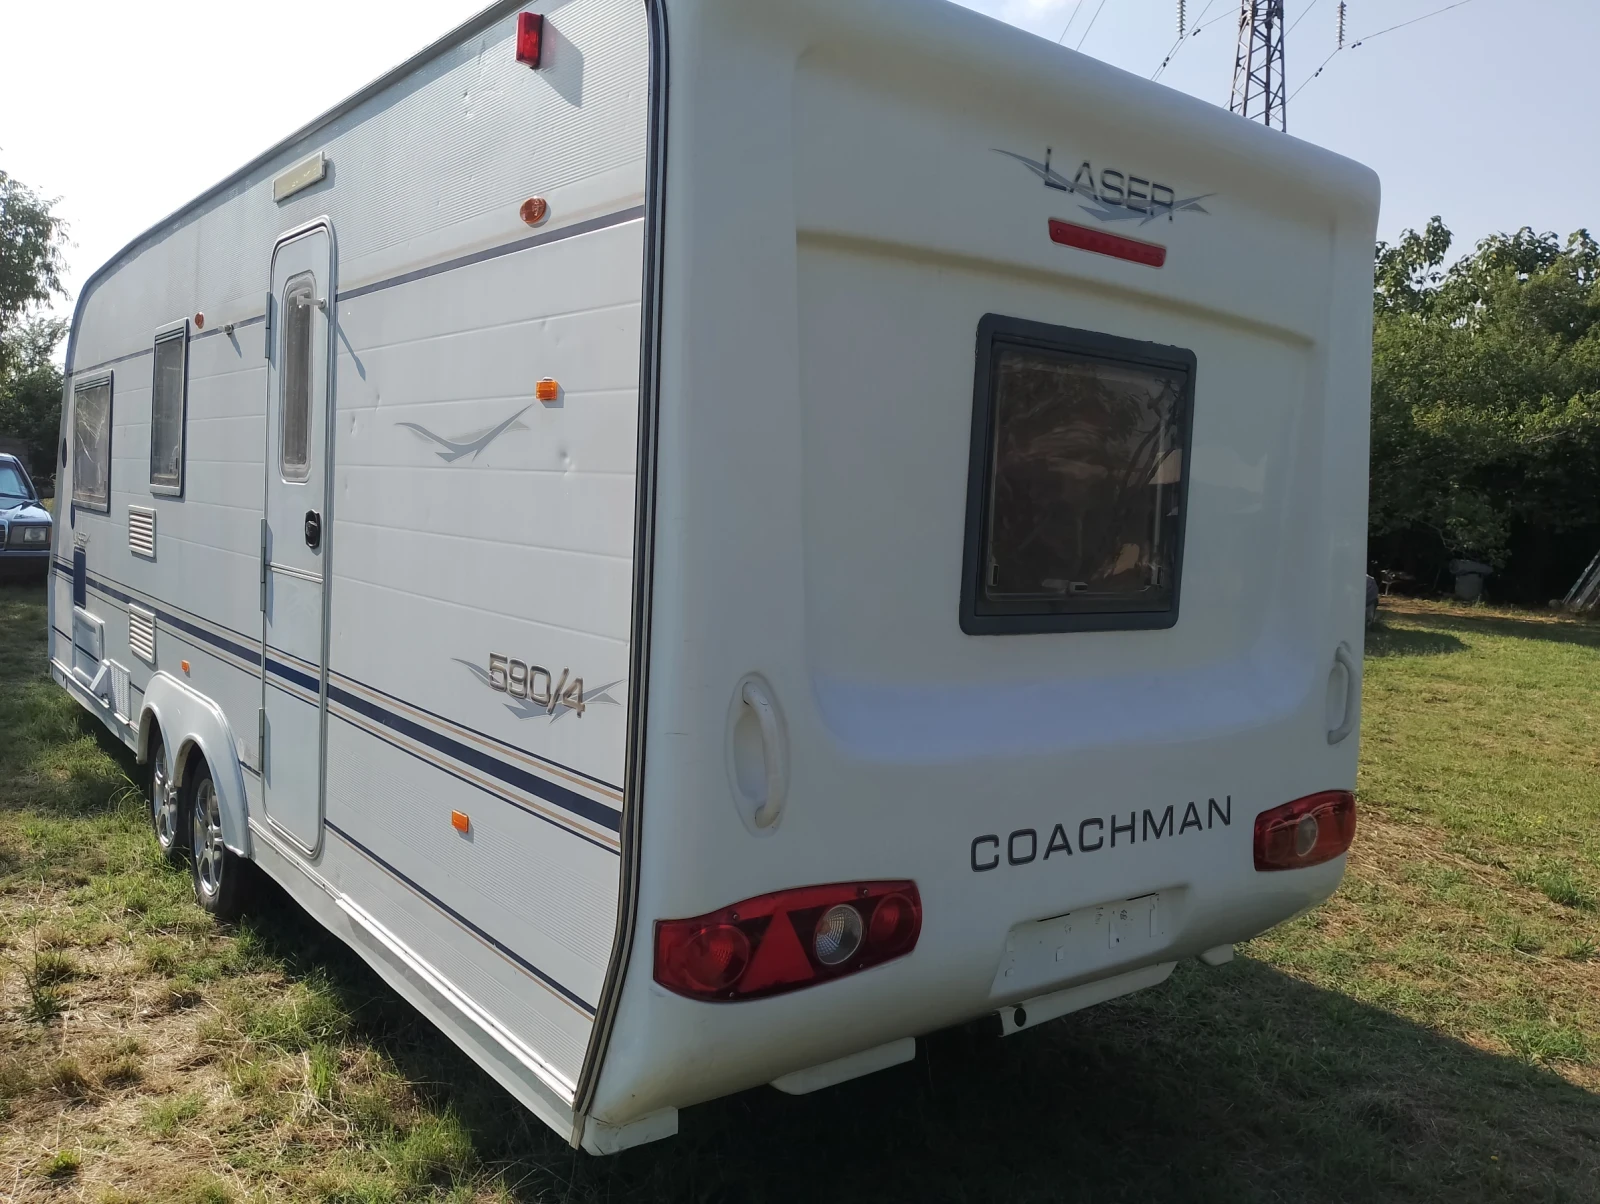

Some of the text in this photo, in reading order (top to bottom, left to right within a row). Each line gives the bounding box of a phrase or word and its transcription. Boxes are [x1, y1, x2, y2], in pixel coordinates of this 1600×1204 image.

[1044, 146, 1175, 221] LASER
[489, 652, 585, 718] 590/4
[971, 795, 1231, 872] COACHMAN
